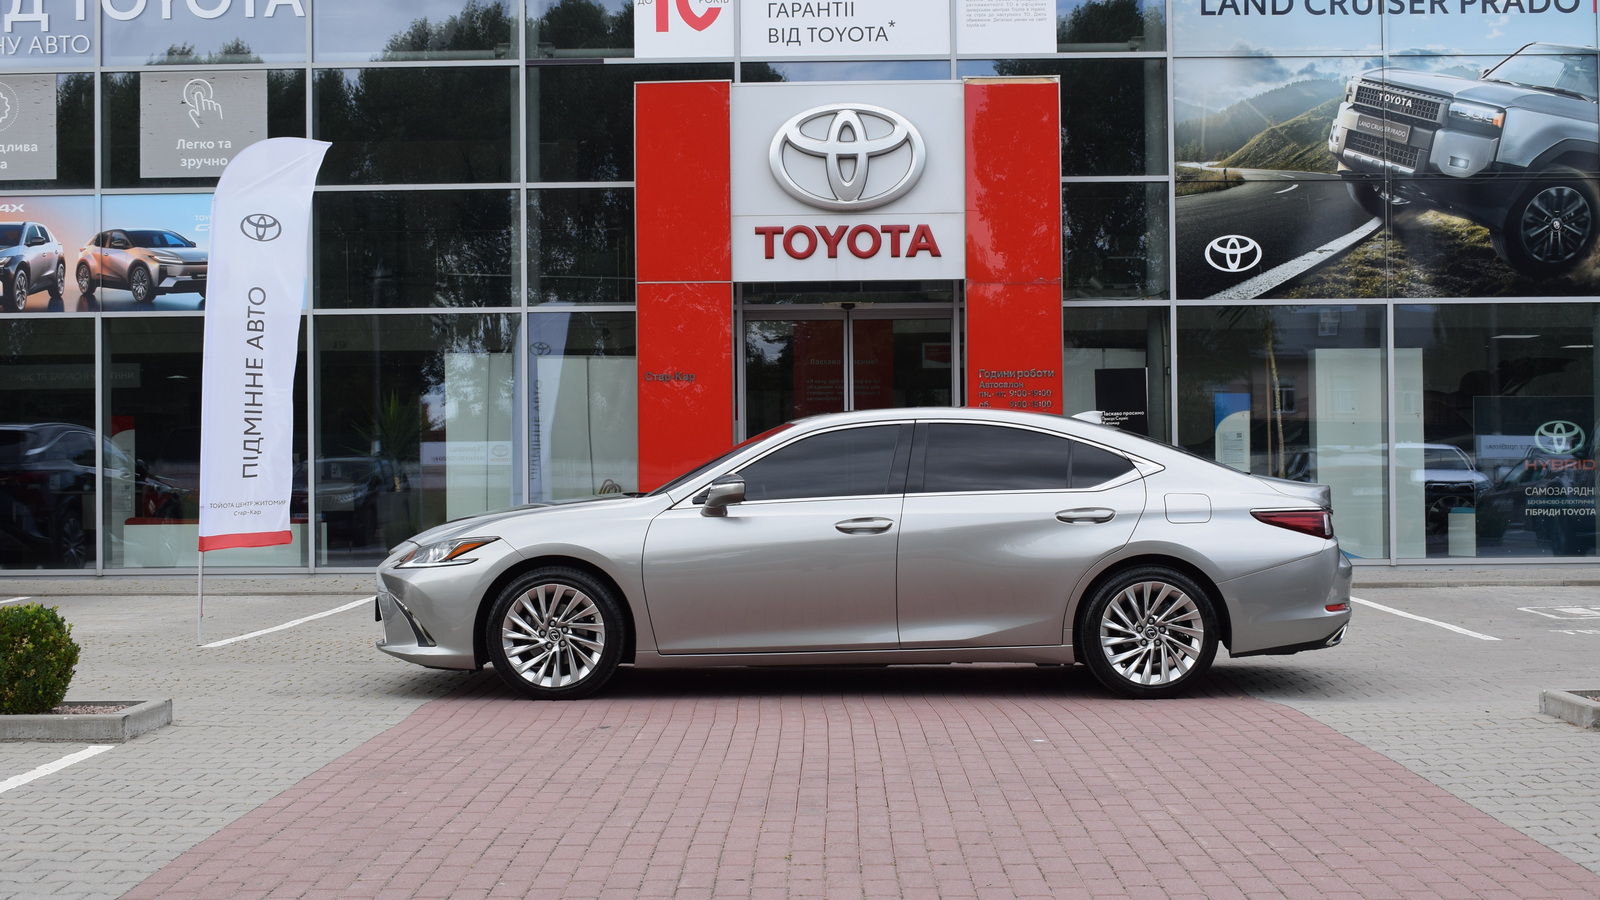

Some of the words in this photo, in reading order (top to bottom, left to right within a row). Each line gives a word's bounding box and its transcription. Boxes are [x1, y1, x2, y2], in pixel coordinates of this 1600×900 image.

[768, 27, 801, 46] ВІД
[28, 34, 91, 54] АВТО
[1379, 93, 1412, 108] TOYOTA
[176, 139, 214, 150] Легко
[218, 140, 231, 149] та
[180, 157, 228, 169] зручно
[755, 224, 942, 260] TOYOTA
[246, 286, 267, 351] АВТО
[645, 371, 697, 383] Стар-Кар
[978, 369, 1016, 379] Години
[1017, 368, 1055, 380] роботи
[978, 381, 1024, 389] Автосалон
[242, 357, 264, 479] ПІДМІННЕ
[1525, 459, 1596, 471] HYBRID
[1525, 508, 1561, 517] ГІБРИДИ
[1561, 508, 1597, 516] TOYOTA
